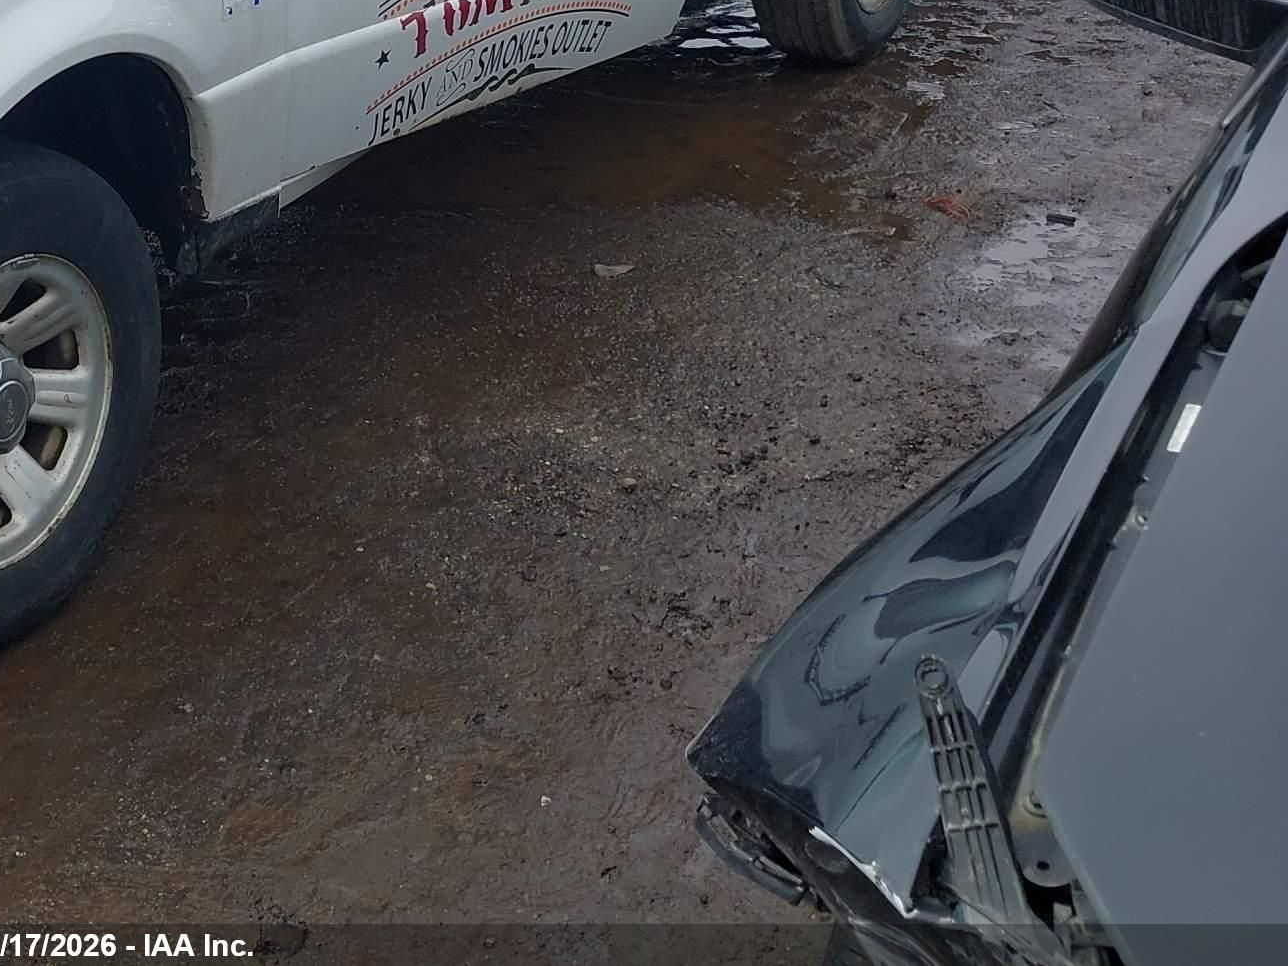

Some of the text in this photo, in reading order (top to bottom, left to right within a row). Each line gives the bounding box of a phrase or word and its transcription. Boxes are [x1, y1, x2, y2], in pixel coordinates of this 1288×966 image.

[367, 20, 613, 146] JERKY AND SMOKIES OUTLET
